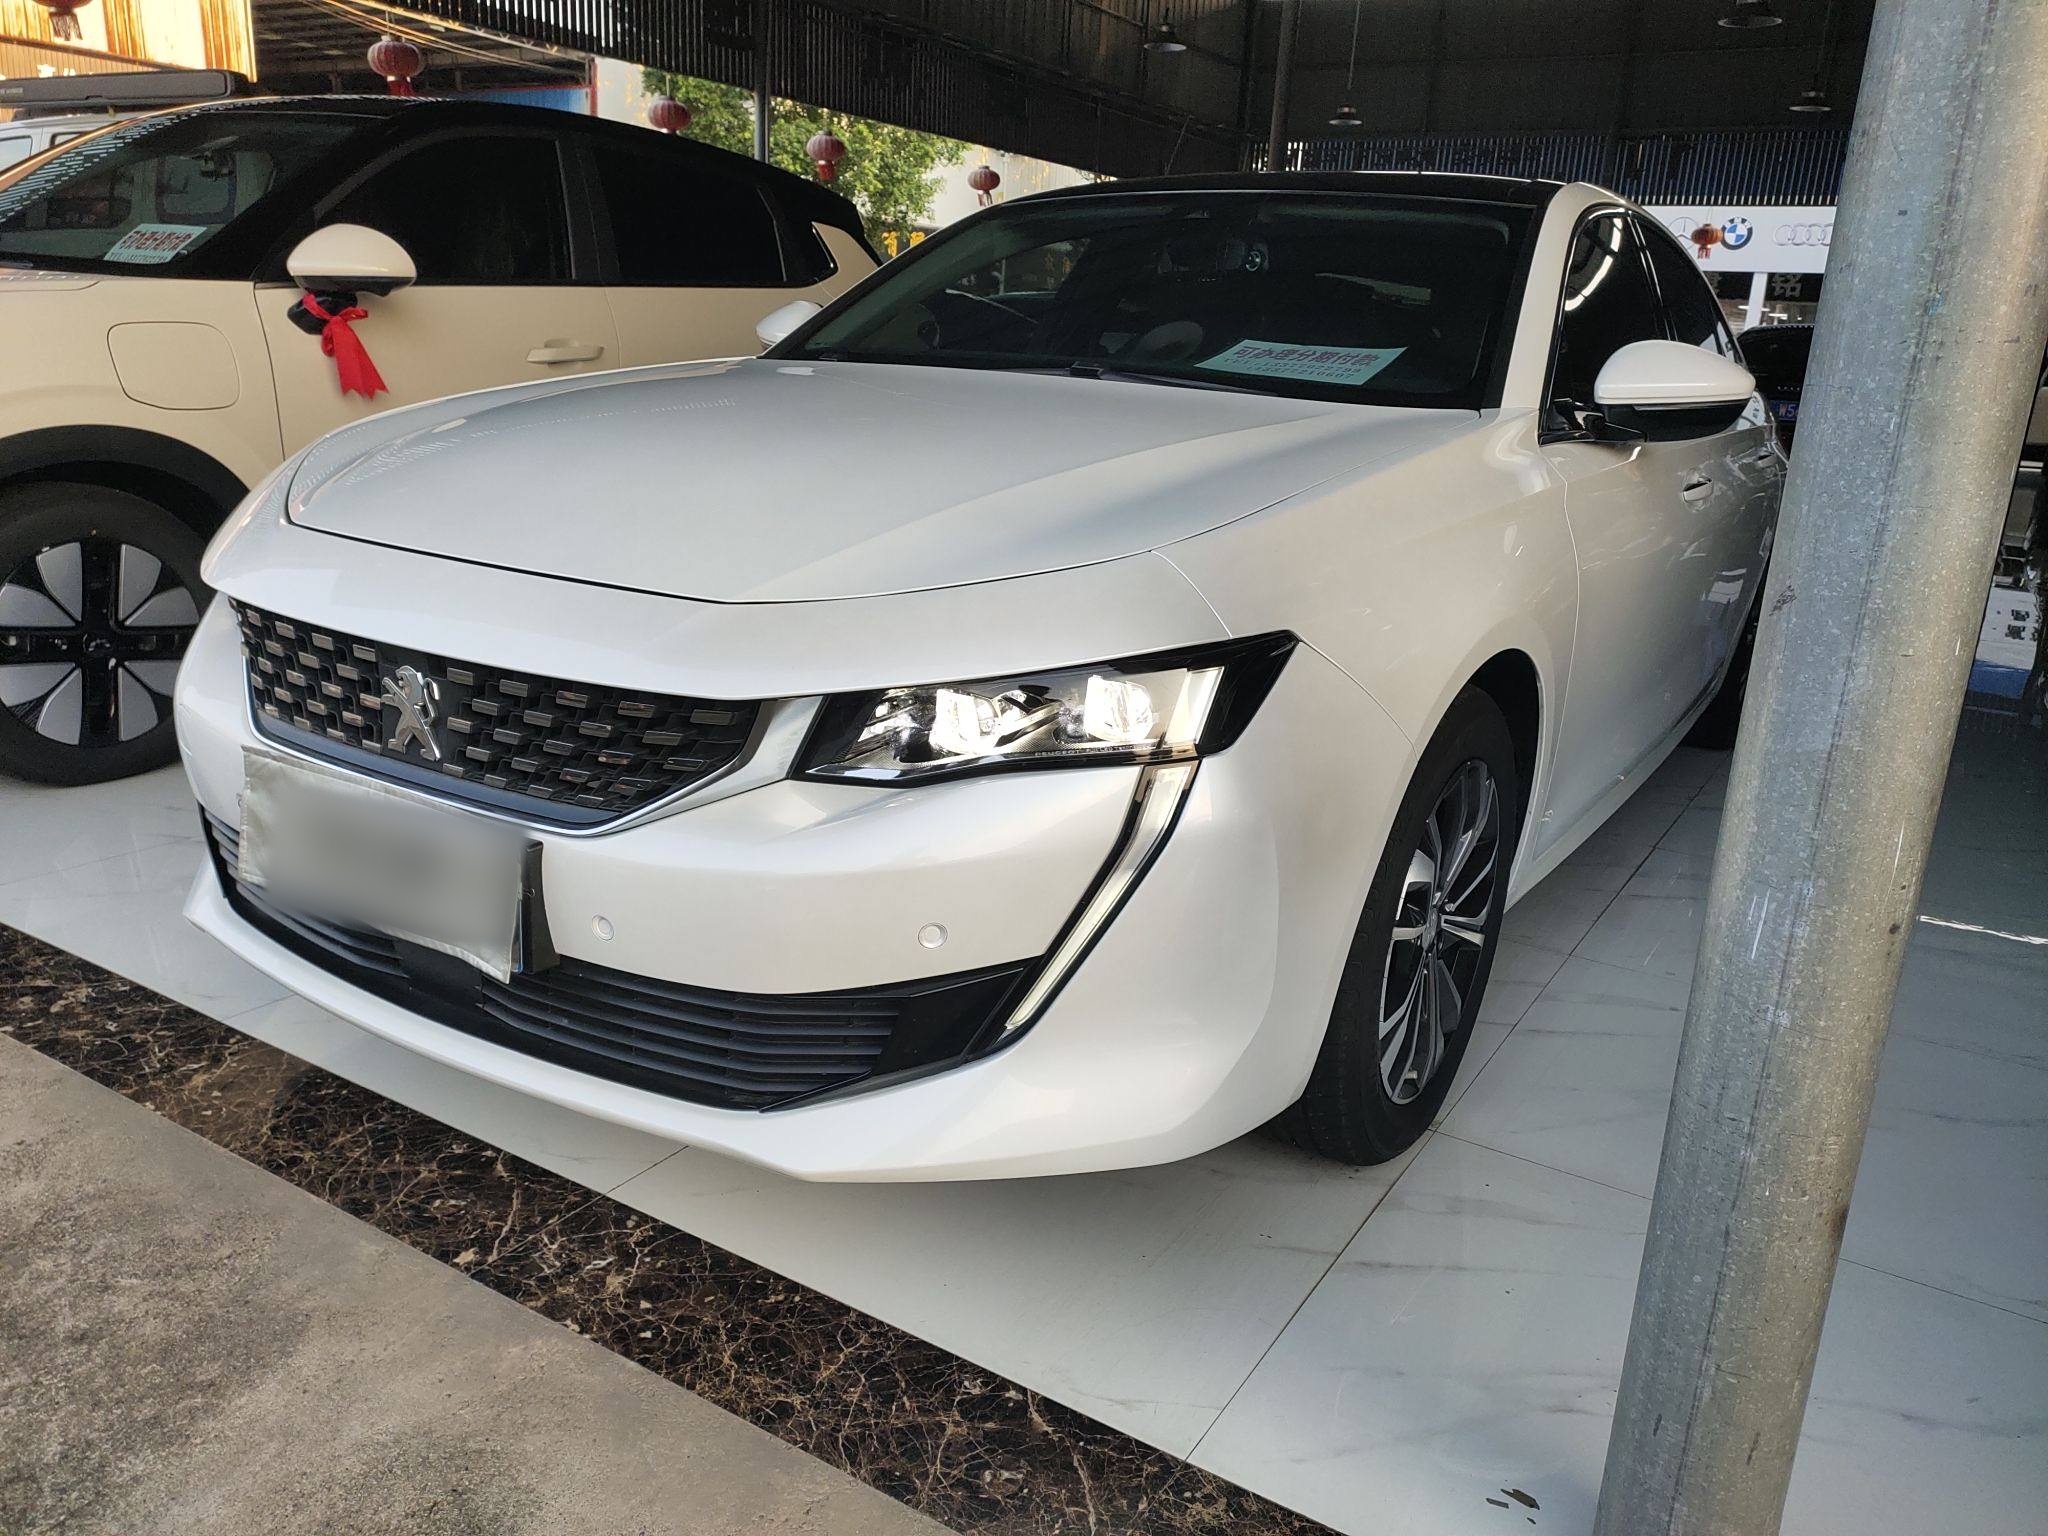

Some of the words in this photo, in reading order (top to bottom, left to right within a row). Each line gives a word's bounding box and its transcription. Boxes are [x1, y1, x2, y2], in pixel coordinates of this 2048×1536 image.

[1234, 346, 1380, 366] 可办理分期付款
